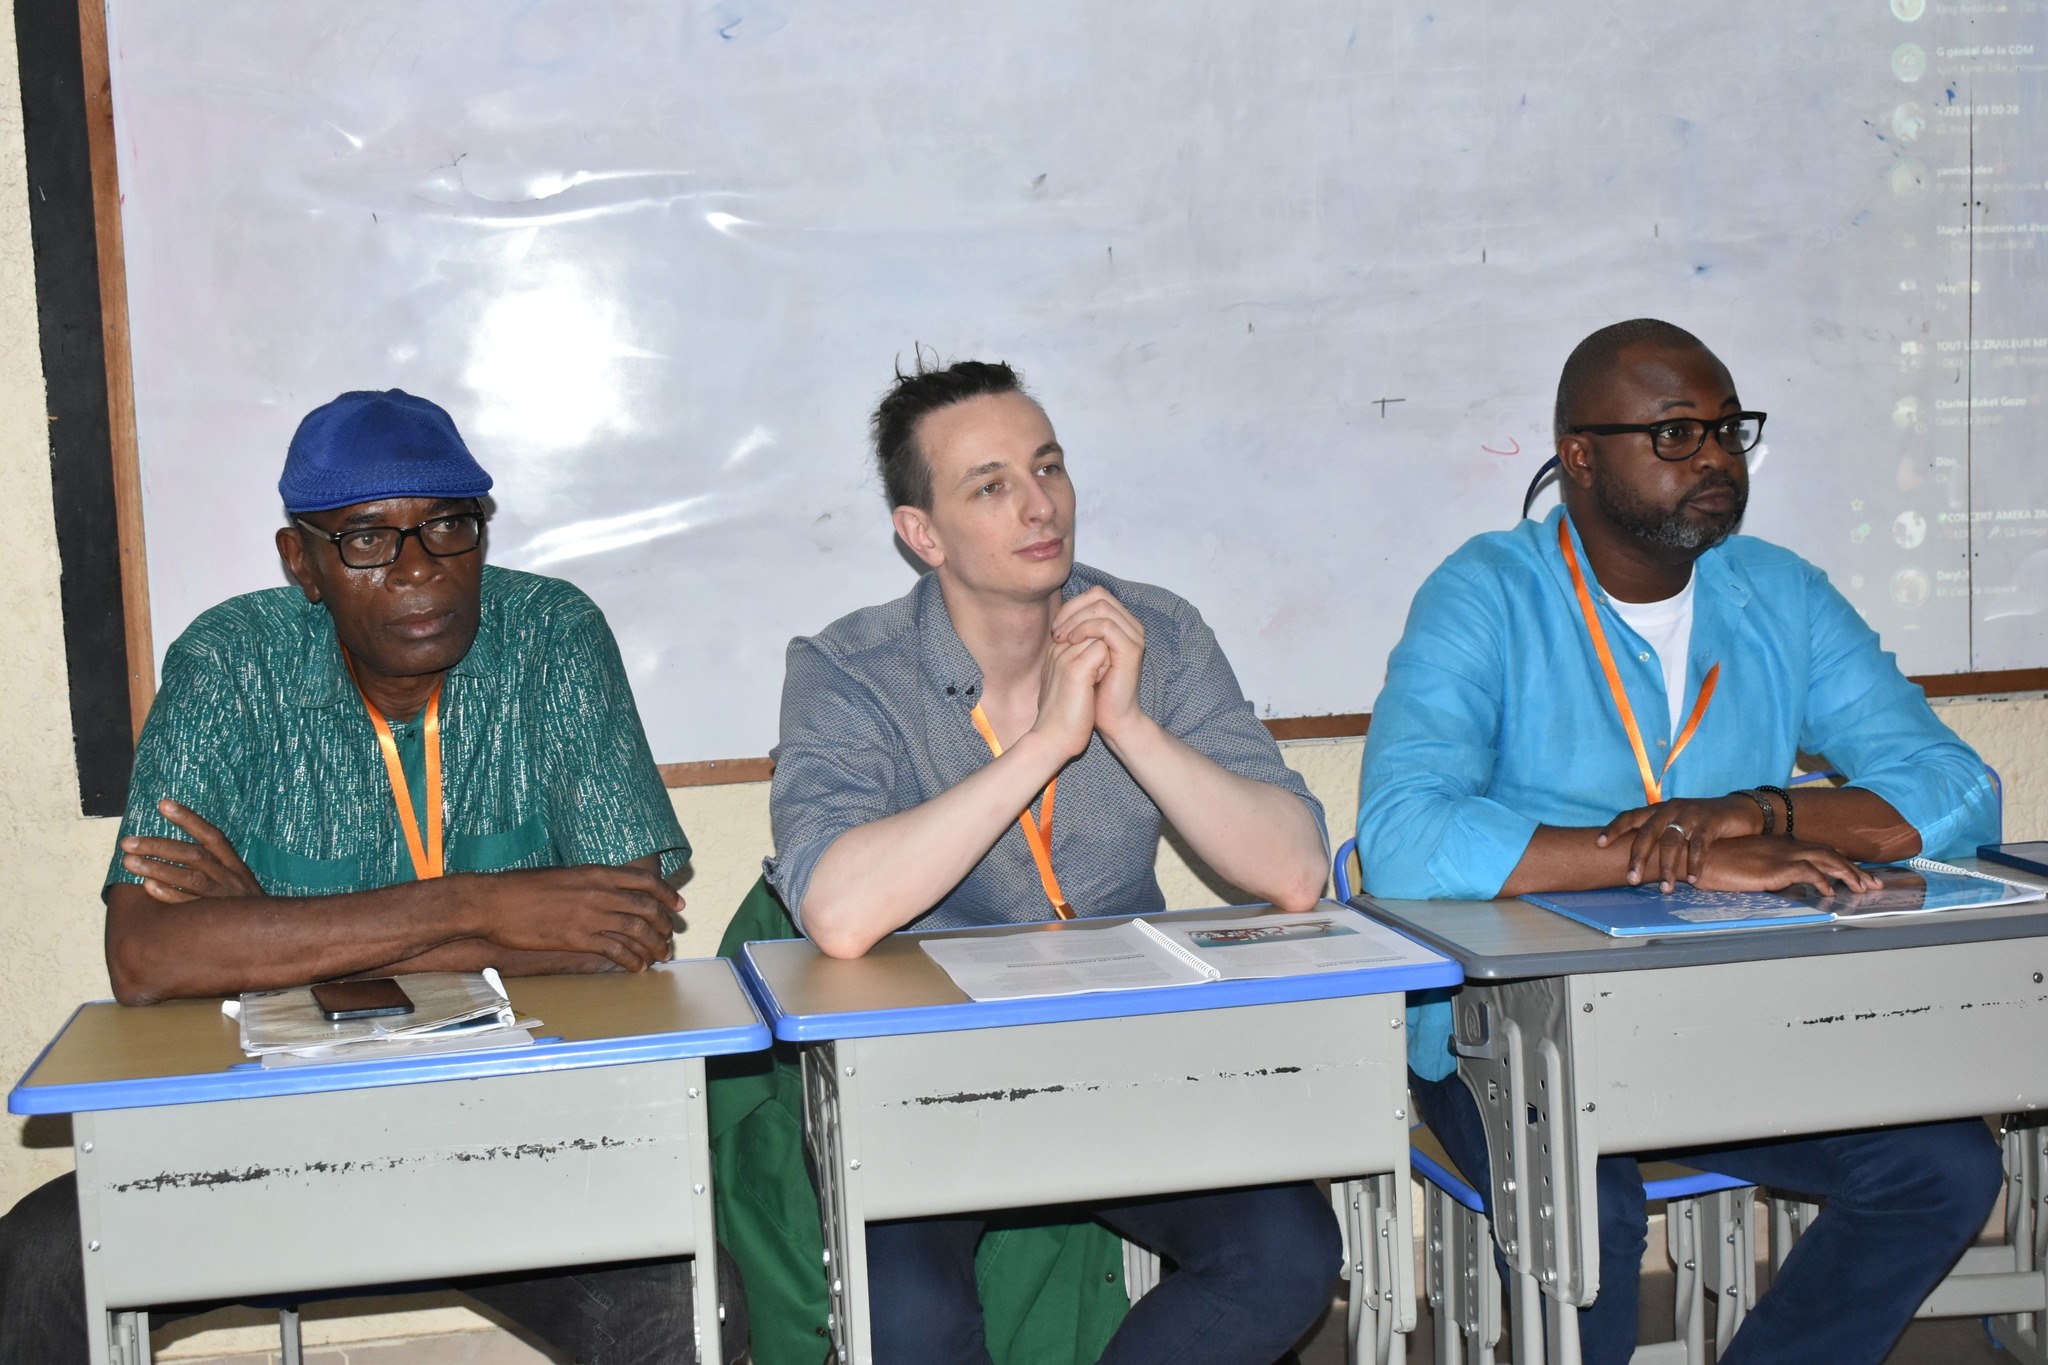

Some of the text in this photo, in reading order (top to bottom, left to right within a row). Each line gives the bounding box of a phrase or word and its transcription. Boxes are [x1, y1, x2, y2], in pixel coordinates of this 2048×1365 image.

[1981, 45, 1995, 55] de
[1996, 44, 2007, 55] la
[1990, 104, 2004, 115] 00
[1937, 341, 1961, 351] TOUT
